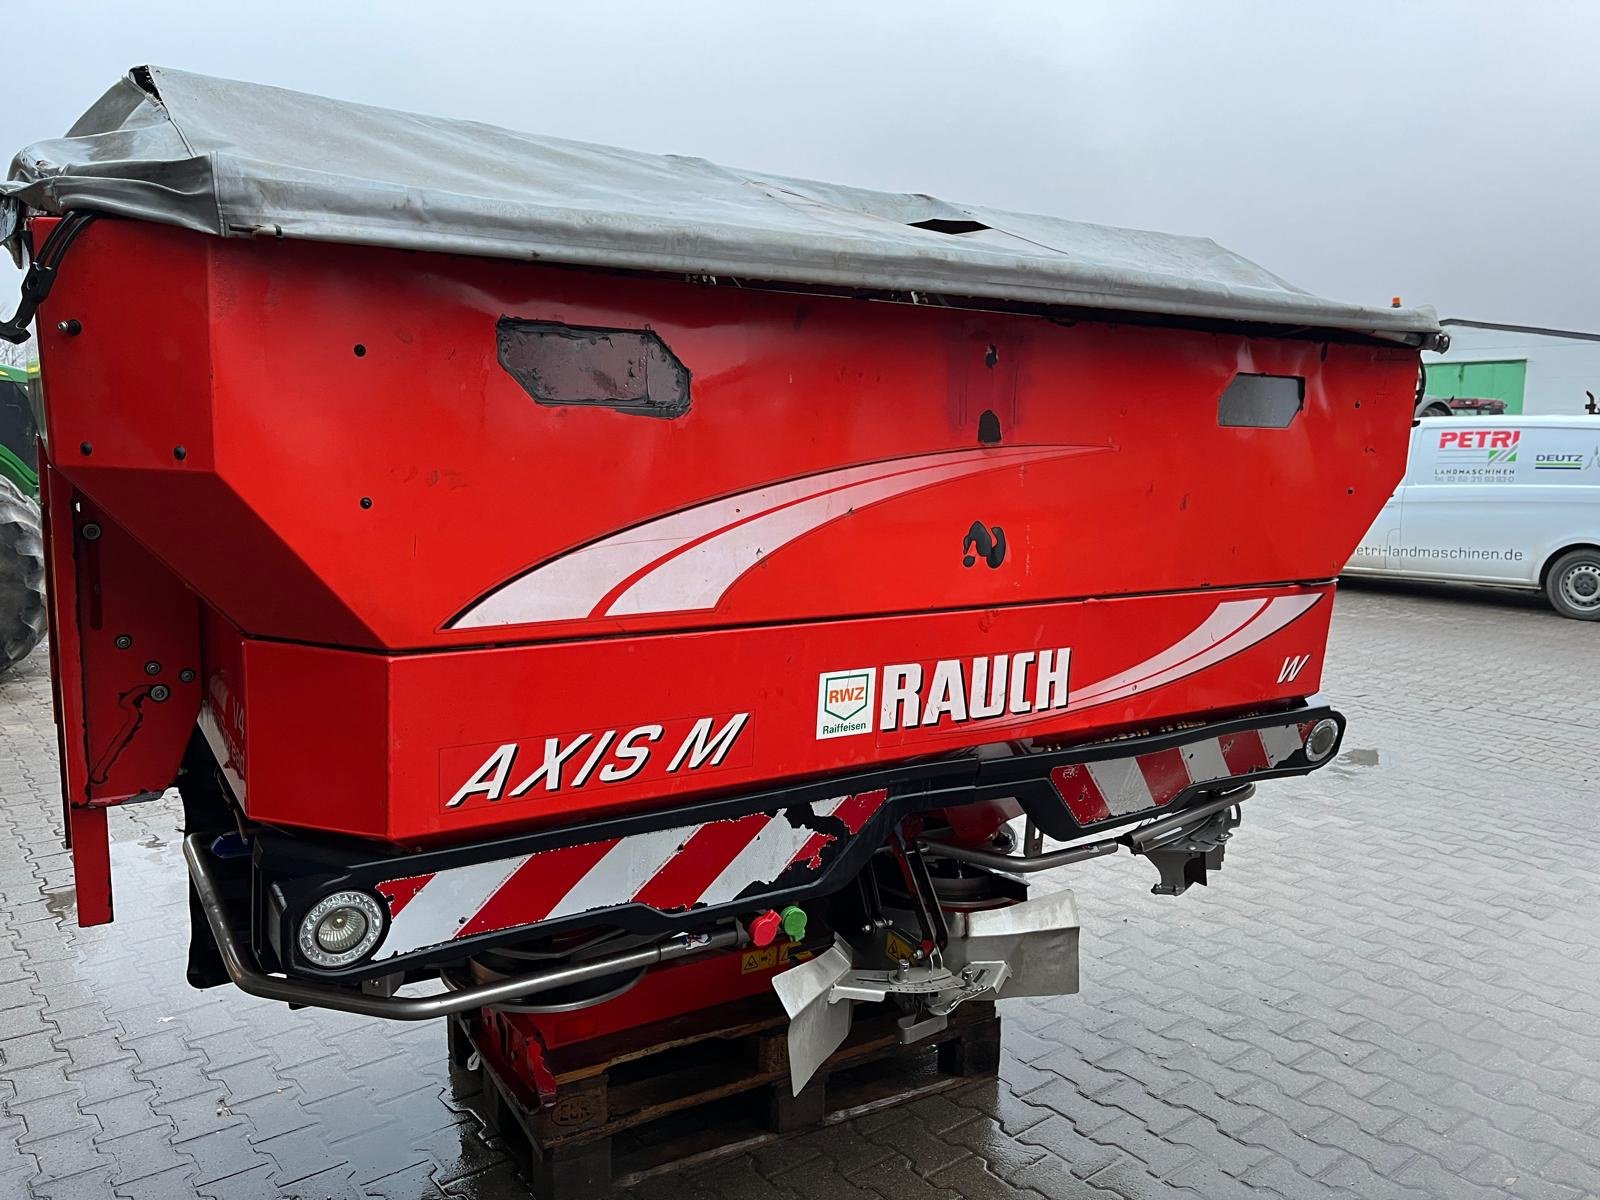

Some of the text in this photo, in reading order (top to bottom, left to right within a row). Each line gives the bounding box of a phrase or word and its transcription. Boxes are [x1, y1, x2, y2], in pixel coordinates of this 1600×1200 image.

[1439, 430, 1521, 449] PETRI
[1536, 454, 1583, 462] DEUTZ
[1434, 468, 1515, 476] LANDMASCHINEN
[1356, 545, 1524, 561] etri-landmaschinen.de
[1276, 654, 1311, 685] W
[828, 687, 865, 704] RWZ
[880, 647, 1072, 731] RAUCH
[822, 721, 867, 735] Raiffeisen
[445, 712, 752, 808] AXIS M
